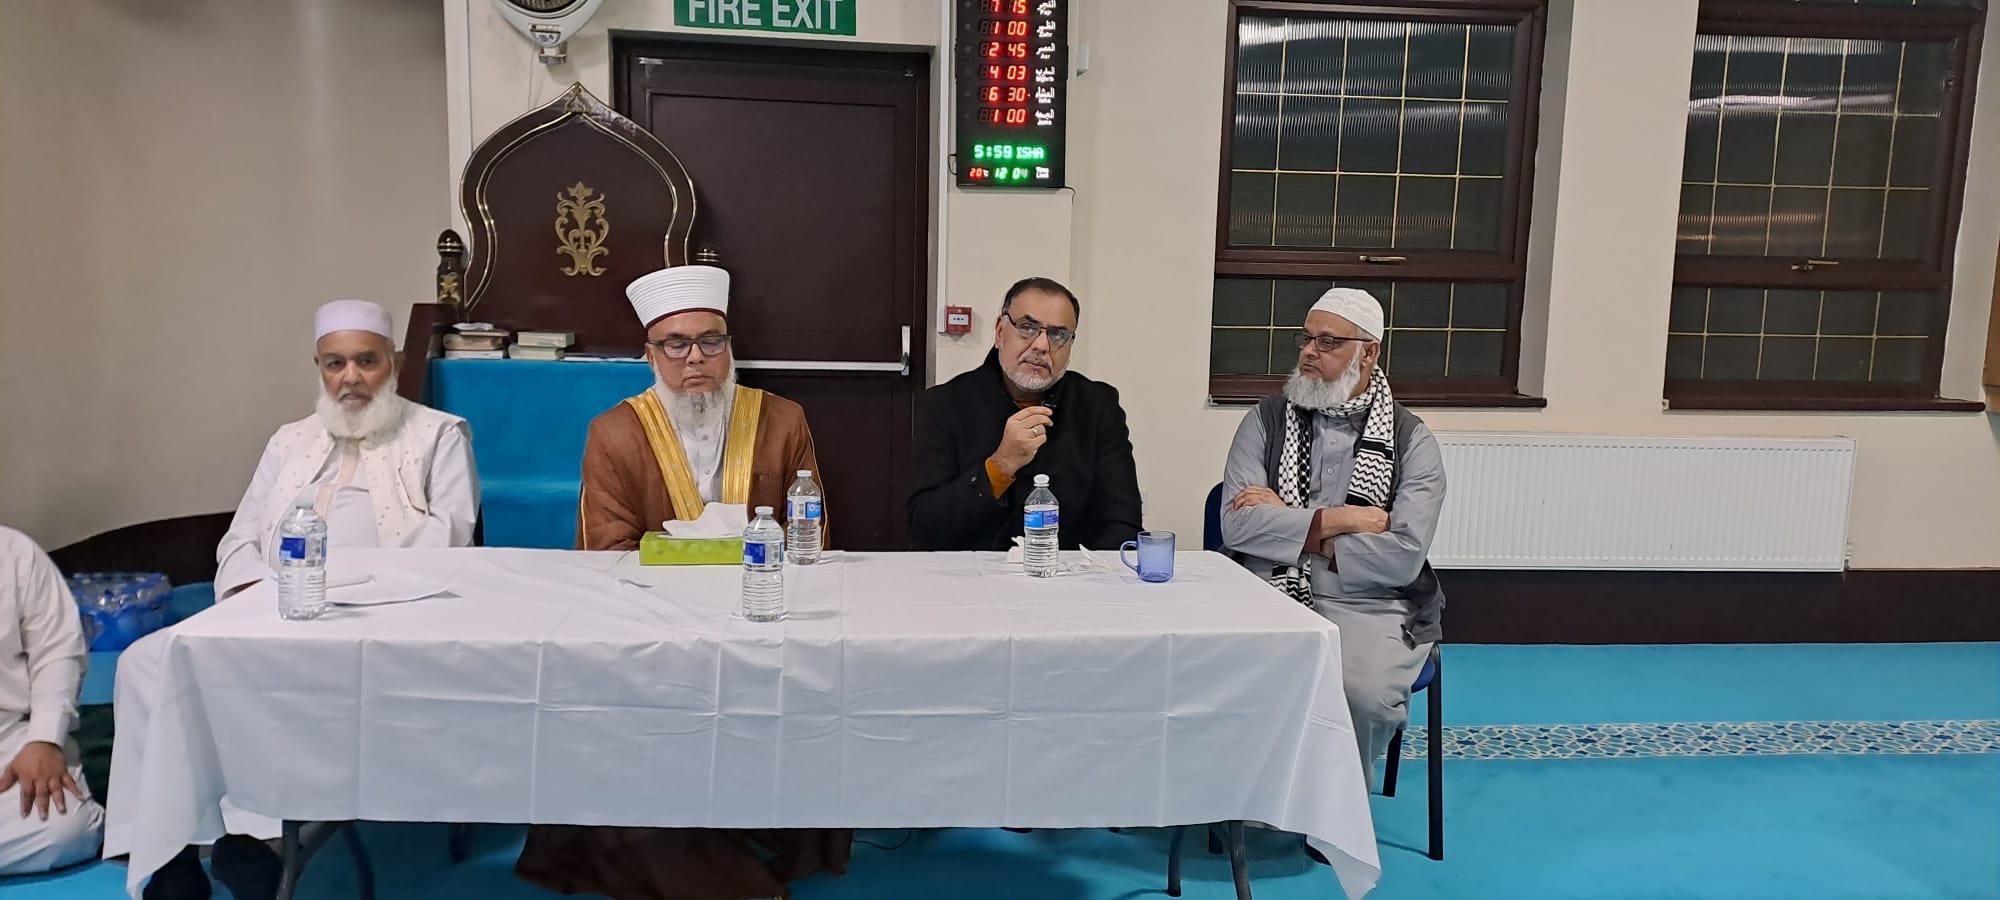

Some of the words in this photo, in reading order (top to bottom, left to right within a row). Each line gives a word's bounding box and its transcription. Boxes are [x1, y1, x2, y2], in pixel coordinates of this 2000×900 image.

[688, 0, 761, 25] FIRE
[772, 0, 843, 30] EXIT
[1007, 21, 1027, 35] 00
[989, 42, 999, 57] 2
[1007, 42, 1026, 57] 45
[989, 65, 999, 79] 4
[1007, 65, 1026, 80] 03
[989, 86, 999, 101] 6
[1007, 86, 1026, 101] 30
[1006, 108, 1026, 123] 00
[974, 144, 1013, 159] 5:59
[1016, 146, 1045, 160] ISHA
